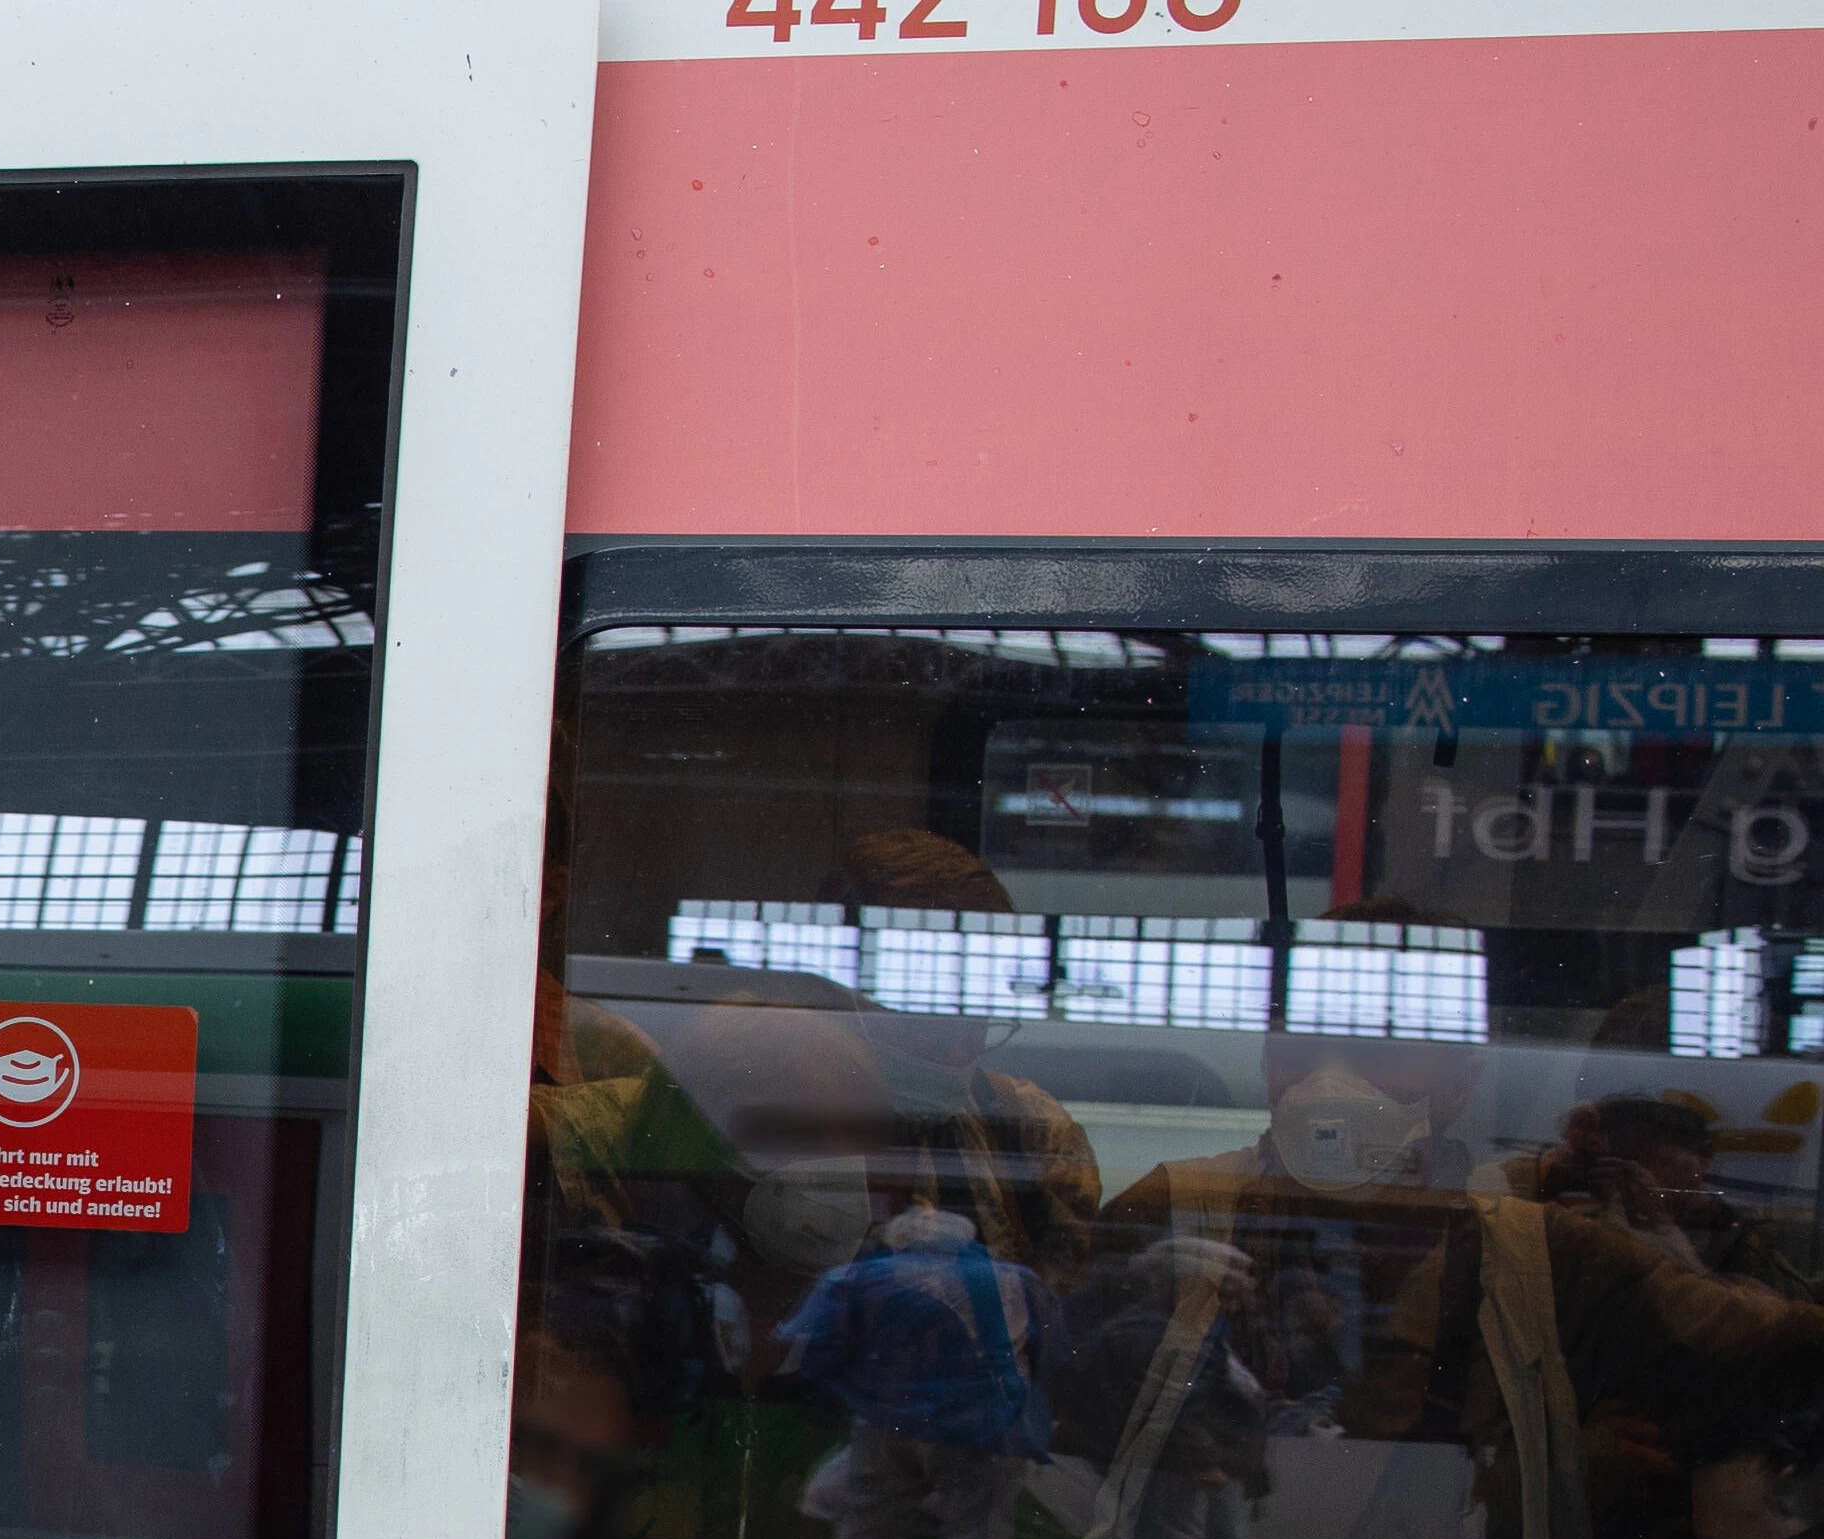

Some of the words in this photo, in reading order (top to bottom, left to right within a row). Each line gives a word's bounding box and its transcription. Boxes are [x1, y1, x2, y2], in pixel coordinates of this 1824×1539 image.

[29, 1150, 61, 1166] nur
[66, 1148, 99, 1168] mit
[95, 1177, 173, 1195] erlaubt!
[4, 1194, 42, 1213] sich
[45, 1197, 83, 1215] und
[86, 1198, 162, 1219] andere!
